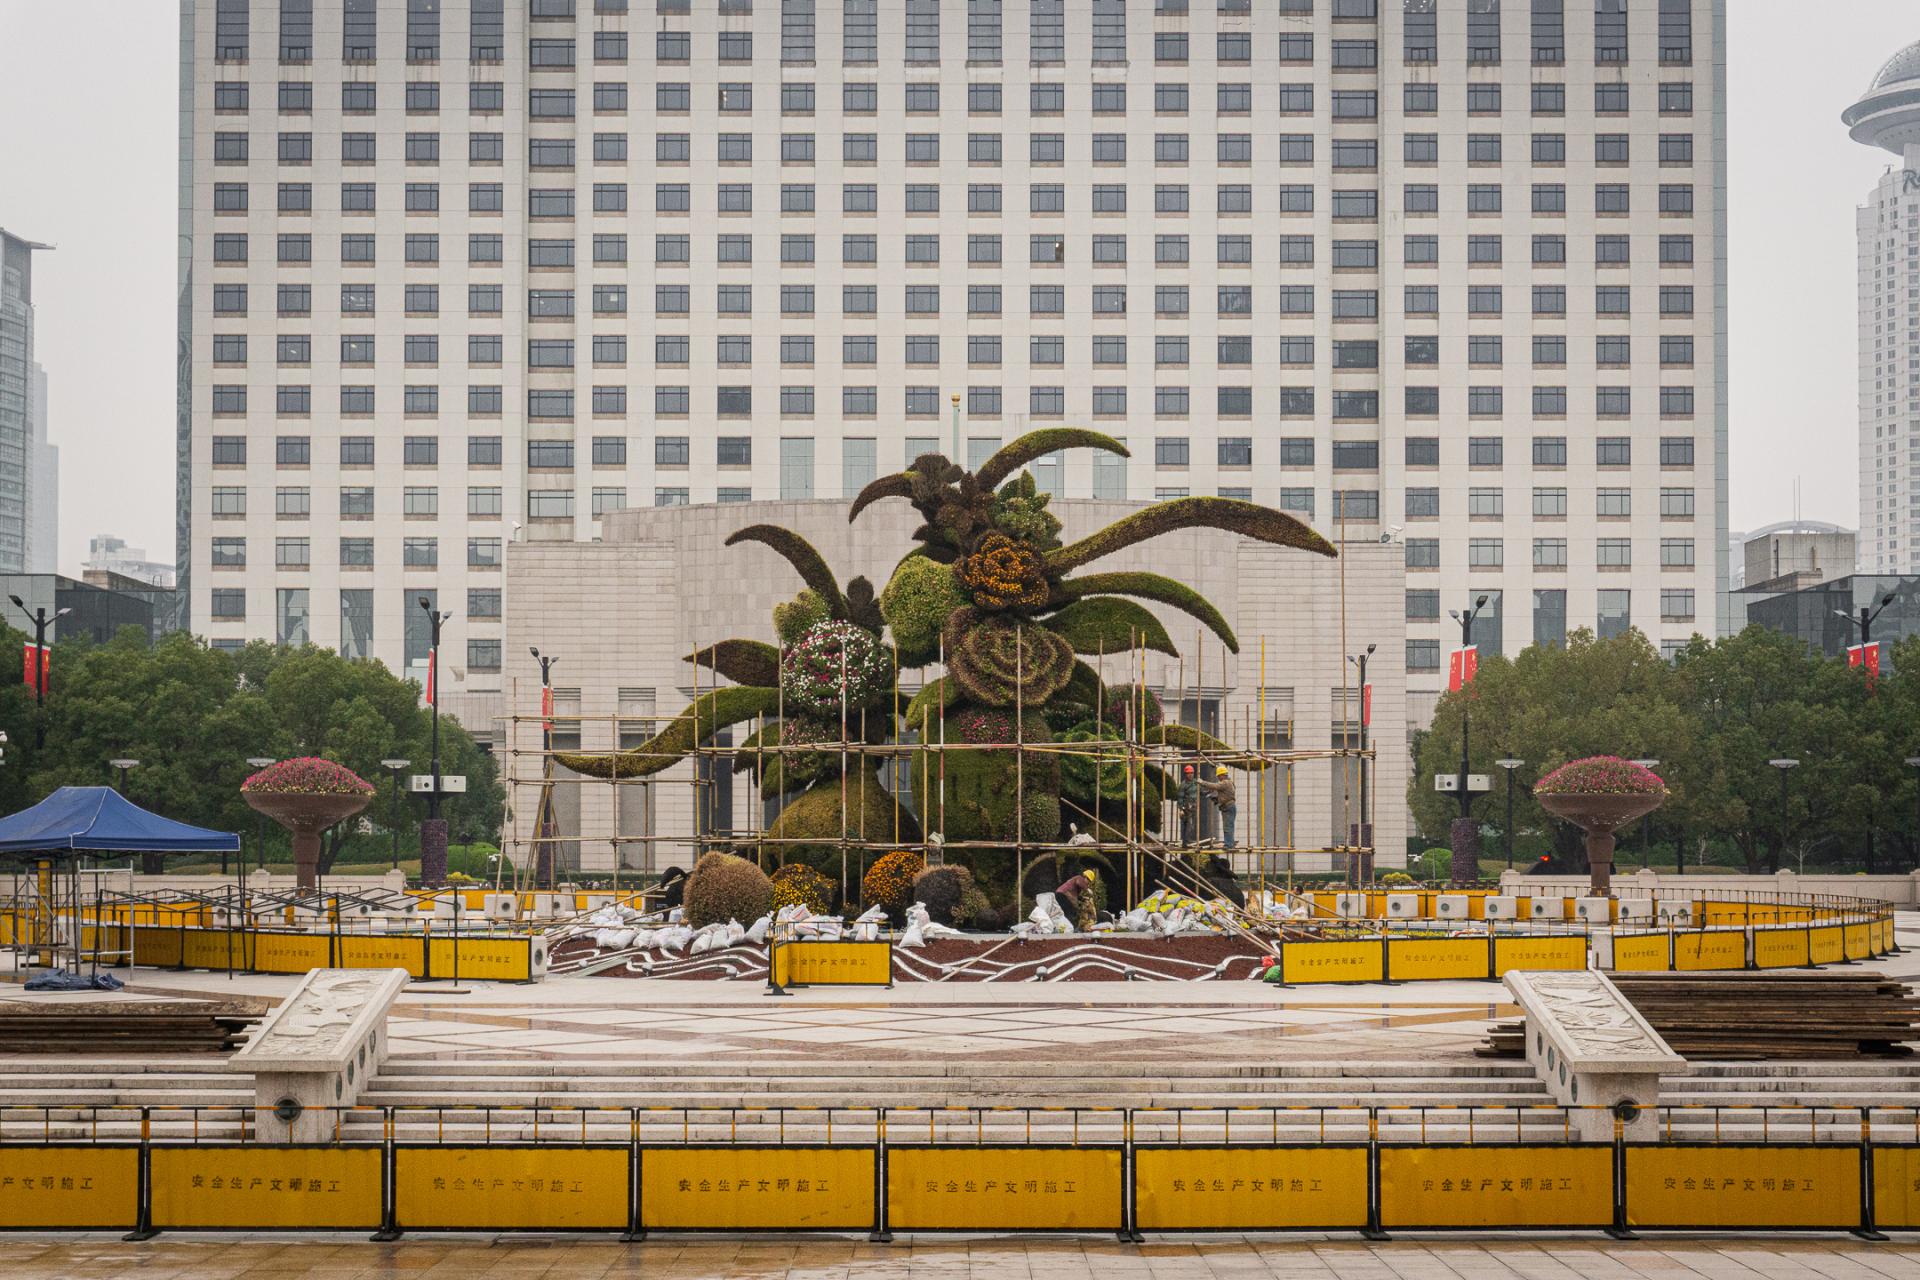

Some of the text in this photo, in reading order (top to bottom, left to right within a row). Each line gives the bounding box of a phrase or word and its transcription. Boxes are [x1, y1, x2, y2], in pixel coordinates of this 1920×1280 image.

[192, 1174, 340, 1192] 安全生产文明施工
[433, 1176, 583, 1193] 安全生产文明施工
[679, 1178, 829, 1192] 安全生产文明施工
[926, 1180, 1076, 1193] 安全生产文明施工
[1173, 1178, 1322, 1192] 安全生产文明施工
[1422, 1178, 1572, 1191] 安全生产文明施工
[1664, 1177, 1815, 1191] 安全生产文明施工
